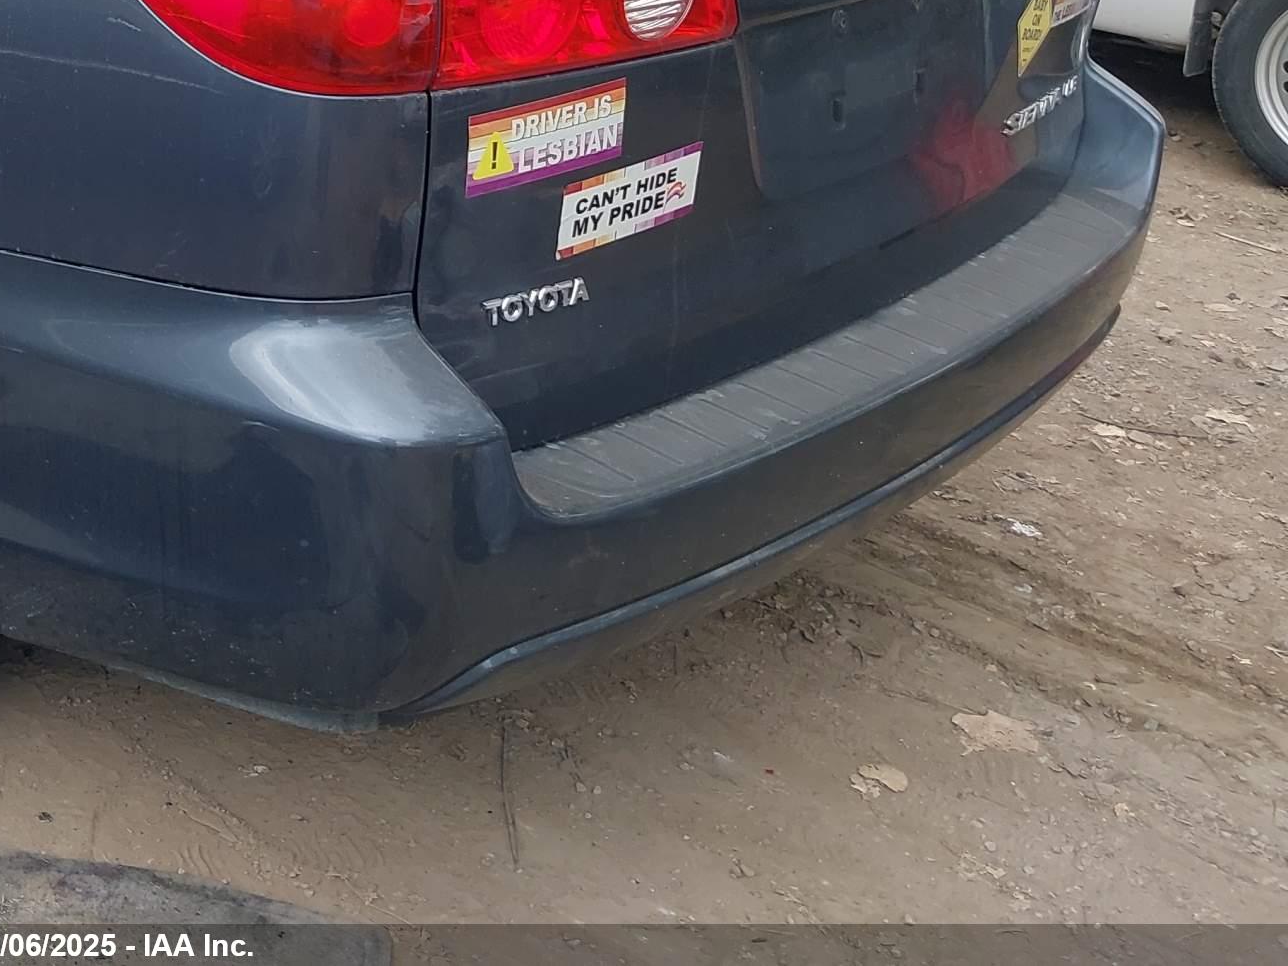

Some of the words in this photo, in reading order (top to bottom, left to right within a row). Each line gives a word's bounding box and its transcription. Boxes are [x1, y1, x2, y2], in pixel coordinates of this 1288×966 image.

[511, 101, 588, 140] DRIVER
[588, 95, 613, 121] IS
[517, 121, 619, 173] LESBIAN
[635, 167, 678, 196] HIDE
[572, 211, 605, 238] MY
[608, 190, 666, 227] PRIDE
[480, 277, 590, 327] TOYOTA
